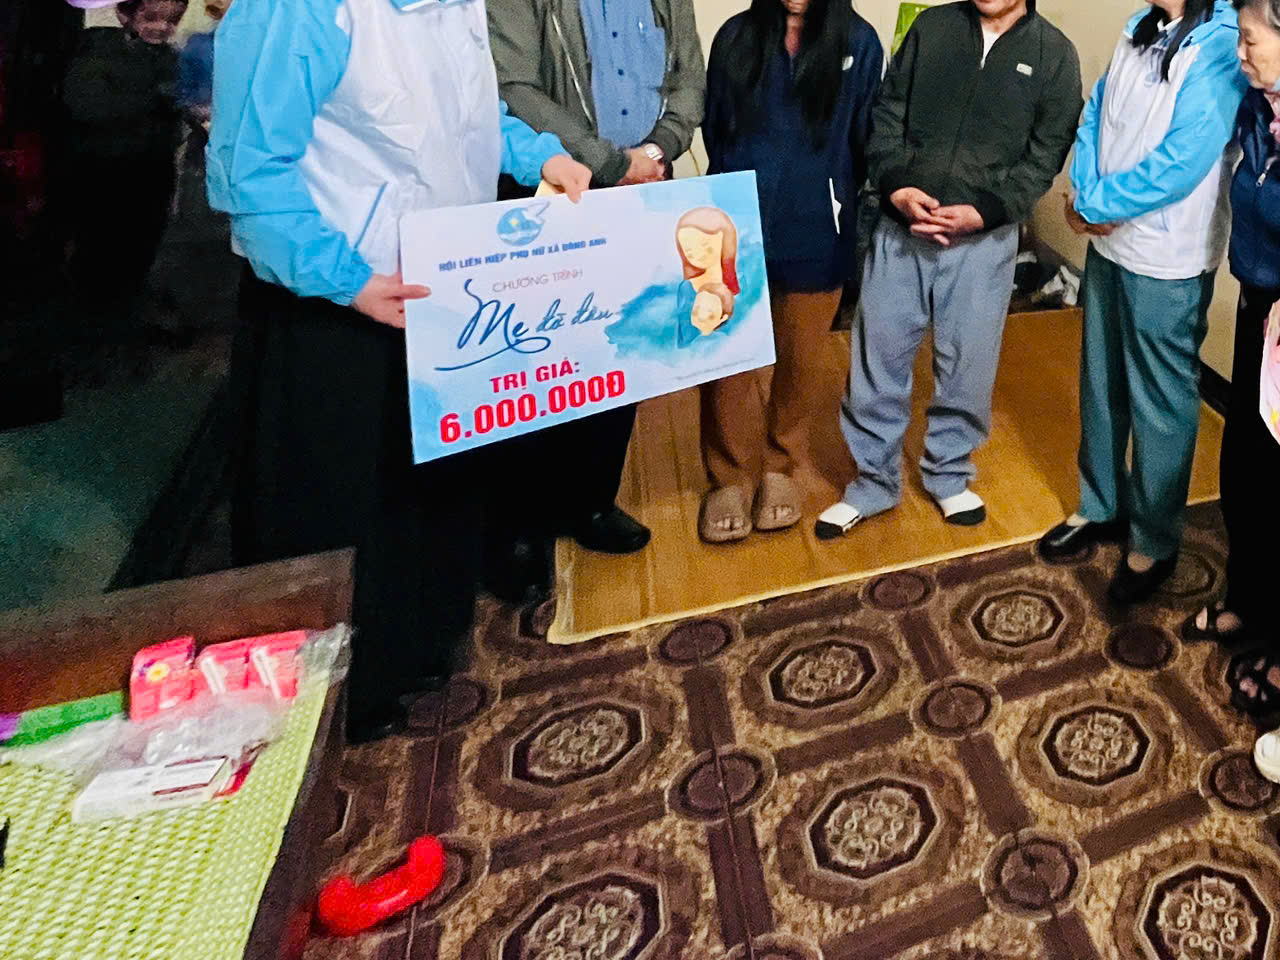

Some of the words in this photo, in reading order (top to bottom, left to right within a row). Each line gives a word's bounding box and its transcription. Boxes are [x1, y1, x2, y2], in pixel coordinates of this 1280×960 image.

[492, 274, 549, 293] CHƯƠNG
[551, 268, 583, 282] TRÌNH
[489, 371, 527, 393] TRỊ
[536, 357, 580, 382] GIÁ:
[440, 370, 626, 444] 6.000.000Đ
